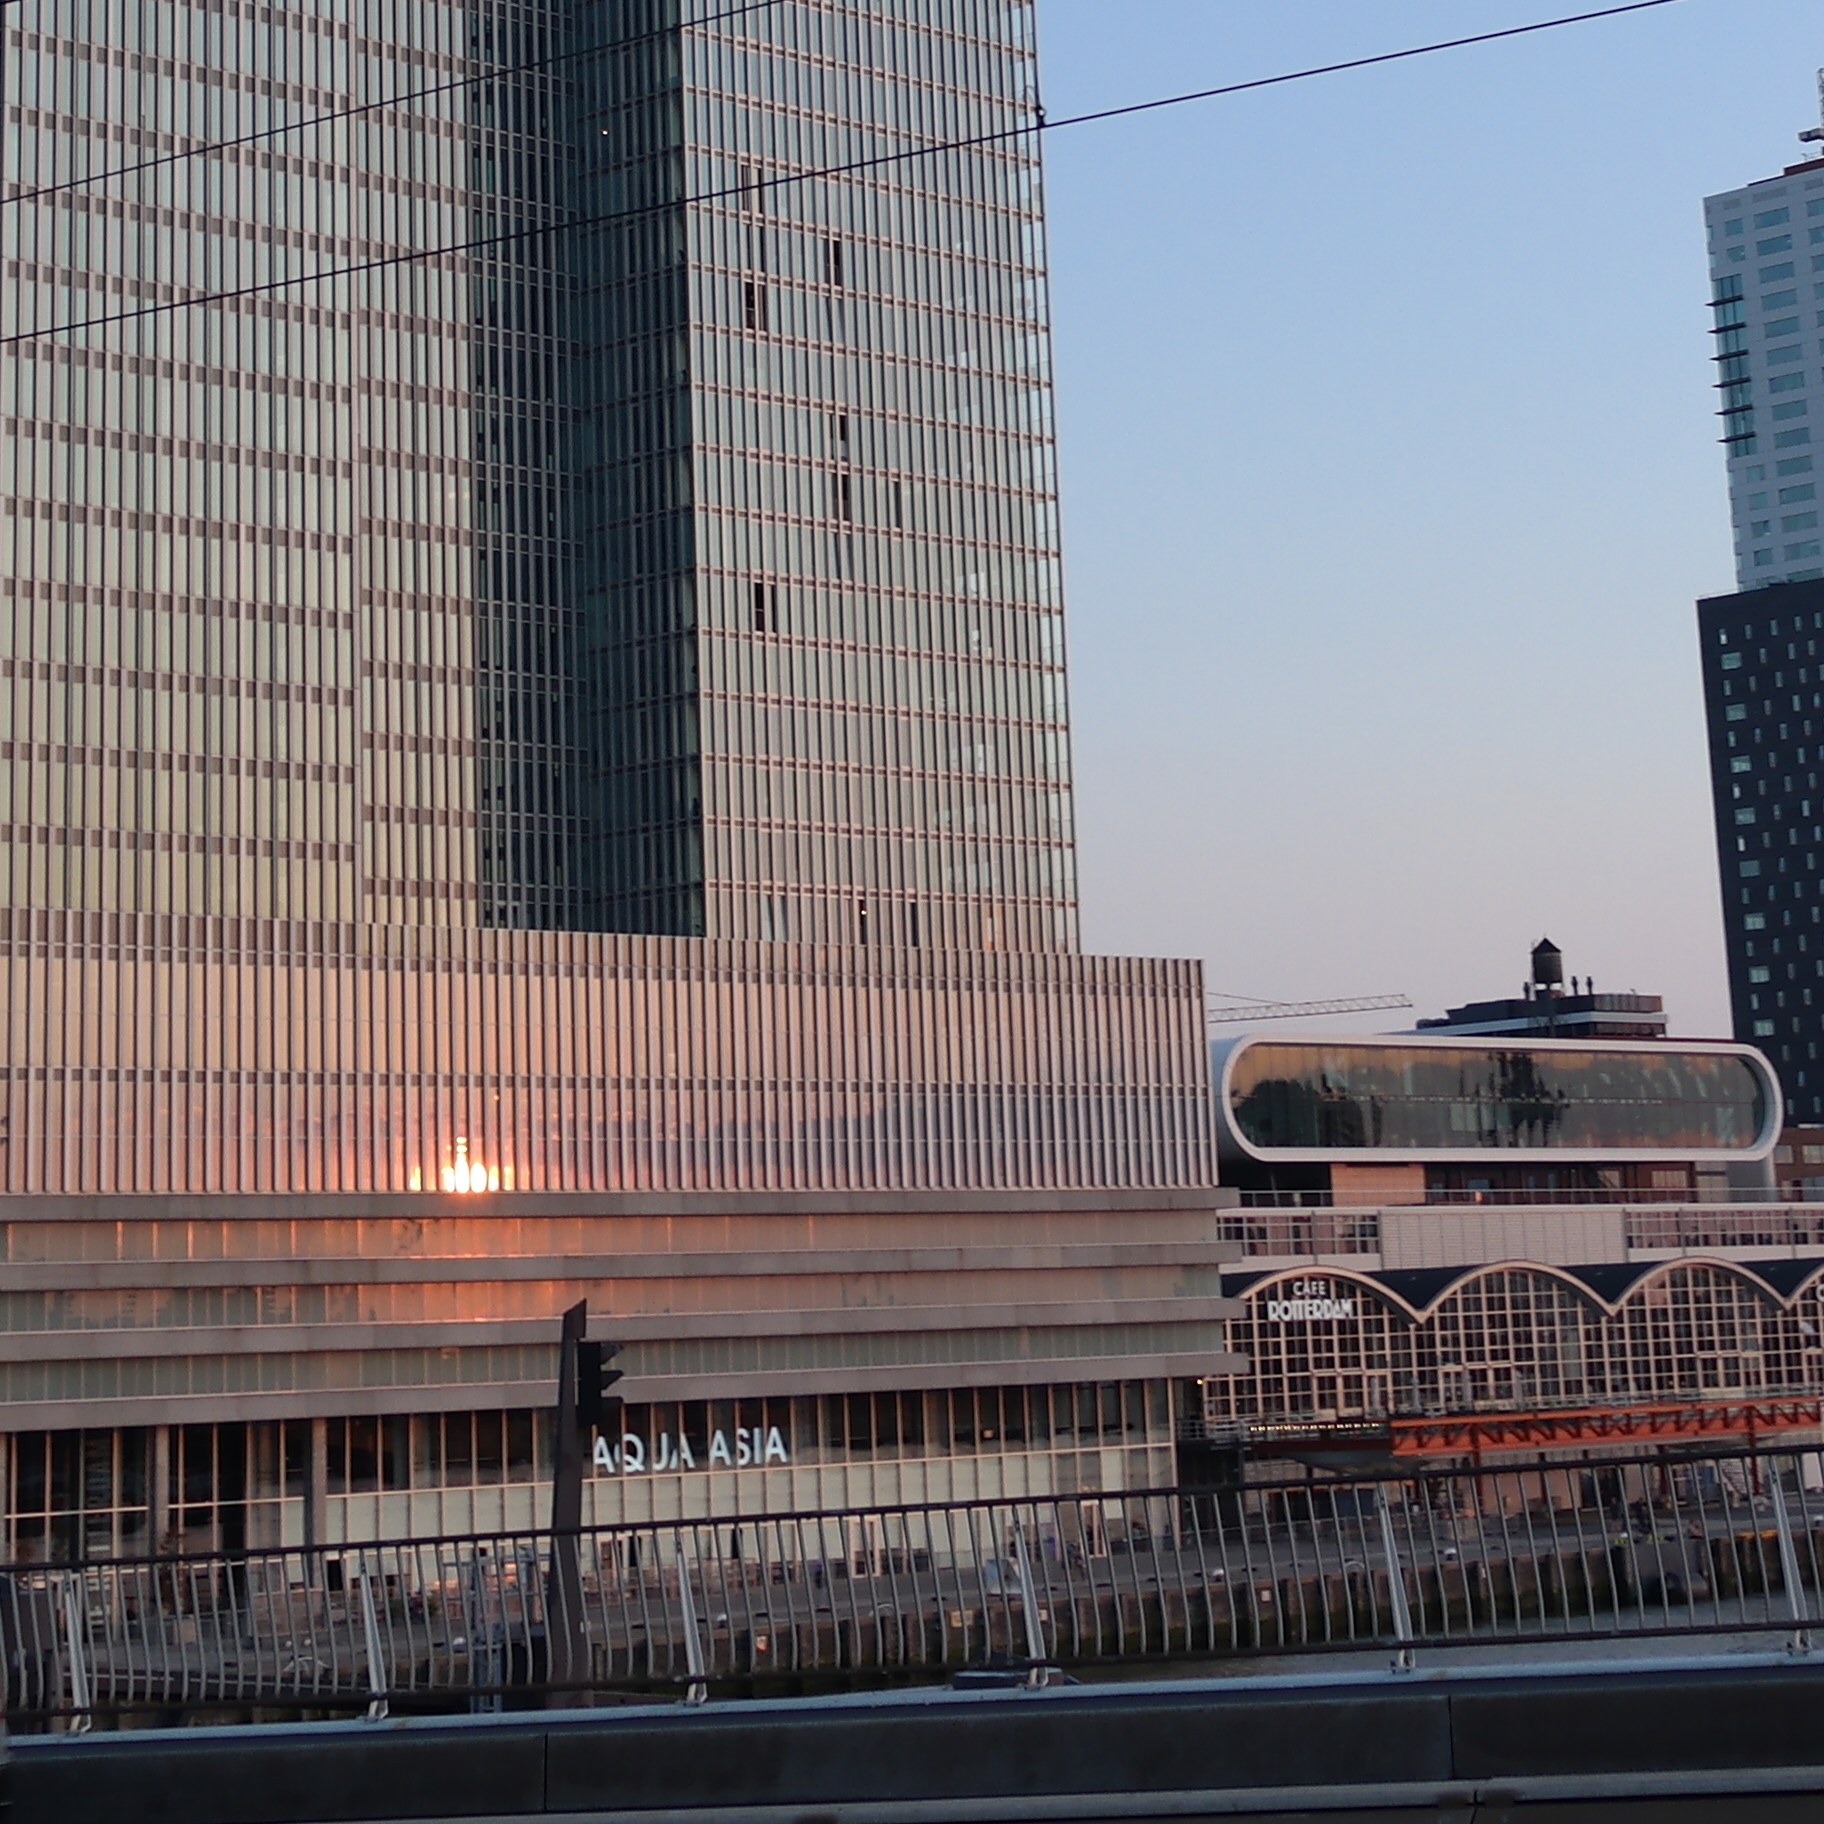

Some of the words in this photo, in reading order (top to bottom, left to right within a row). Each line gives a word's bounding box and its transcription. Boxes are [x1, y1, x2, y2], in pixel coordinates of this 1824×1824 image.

[1267, 1298, 1354, 1322] ROTTERDAM
[592, 1431, 696, 1474] AQUA
[709, 1426, 788, 1468] ASIA
